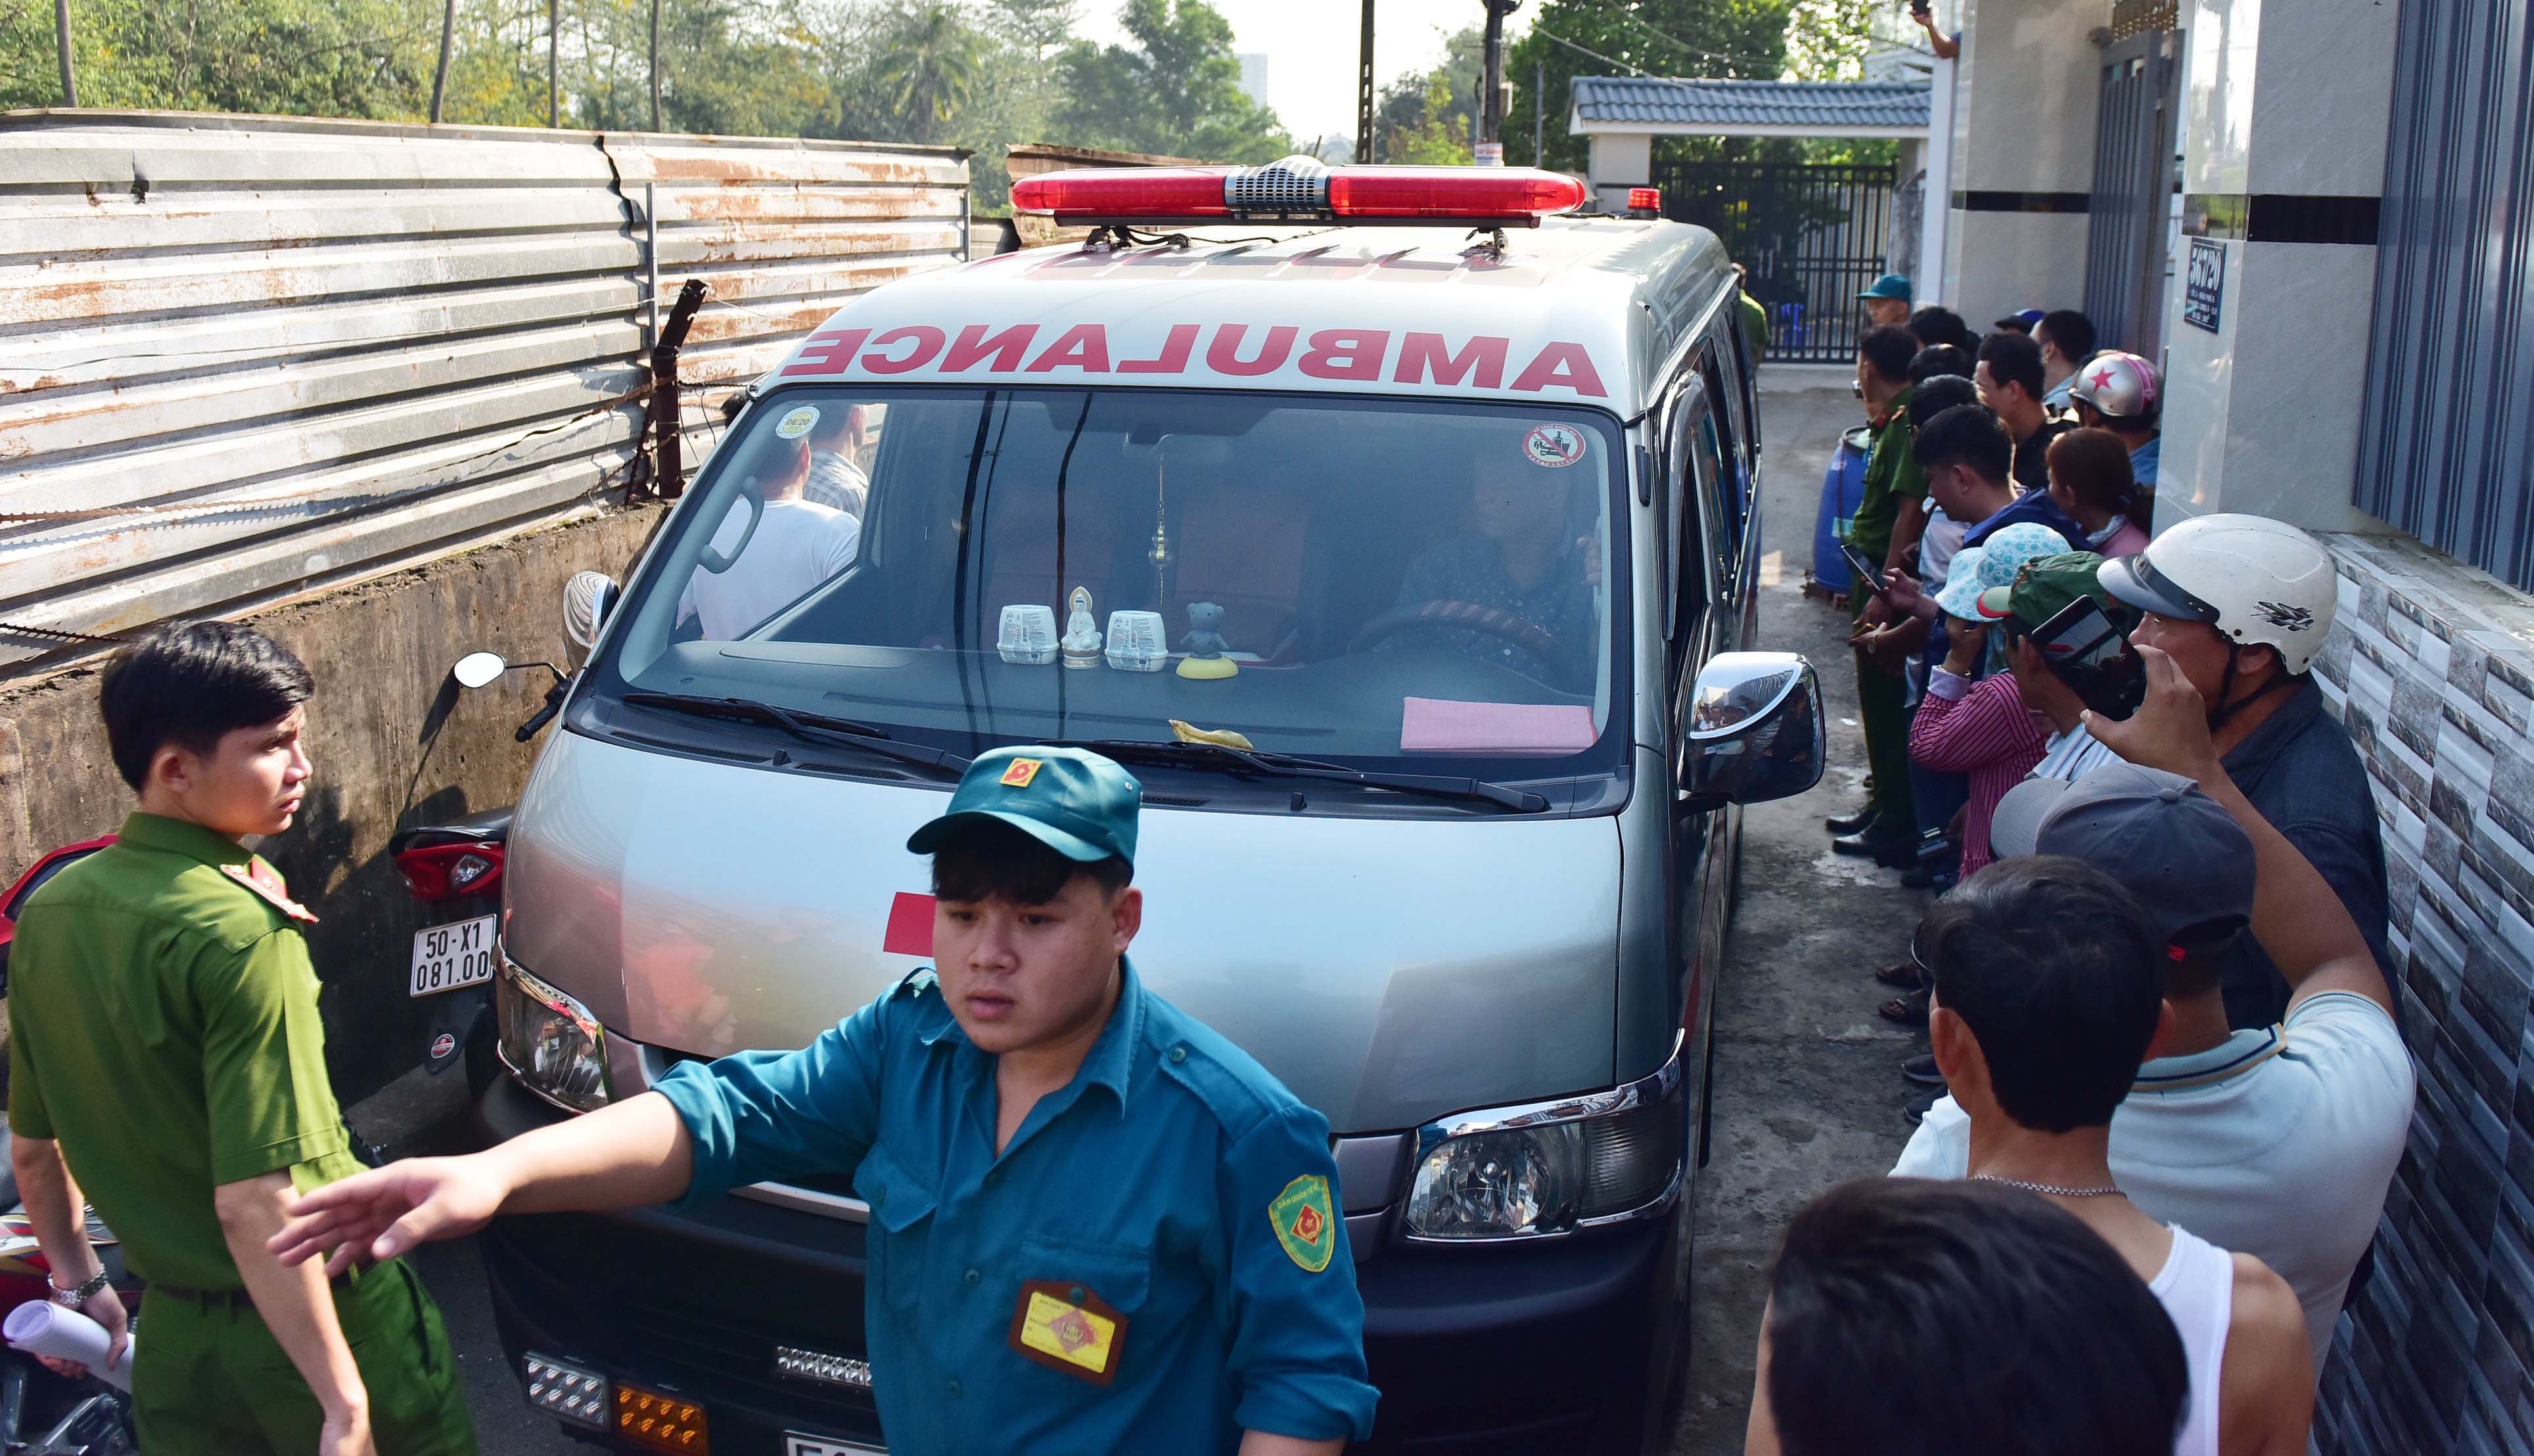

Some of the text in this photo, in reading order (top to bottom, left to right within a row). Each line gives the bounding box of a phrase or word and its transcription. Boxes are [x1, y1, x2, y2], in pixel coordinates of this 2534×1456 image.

[2190, 248, 2221, 290] 567/20
[426, 922, 480, 959] 50-X1
[417, 950, 489, 991] 081.00
